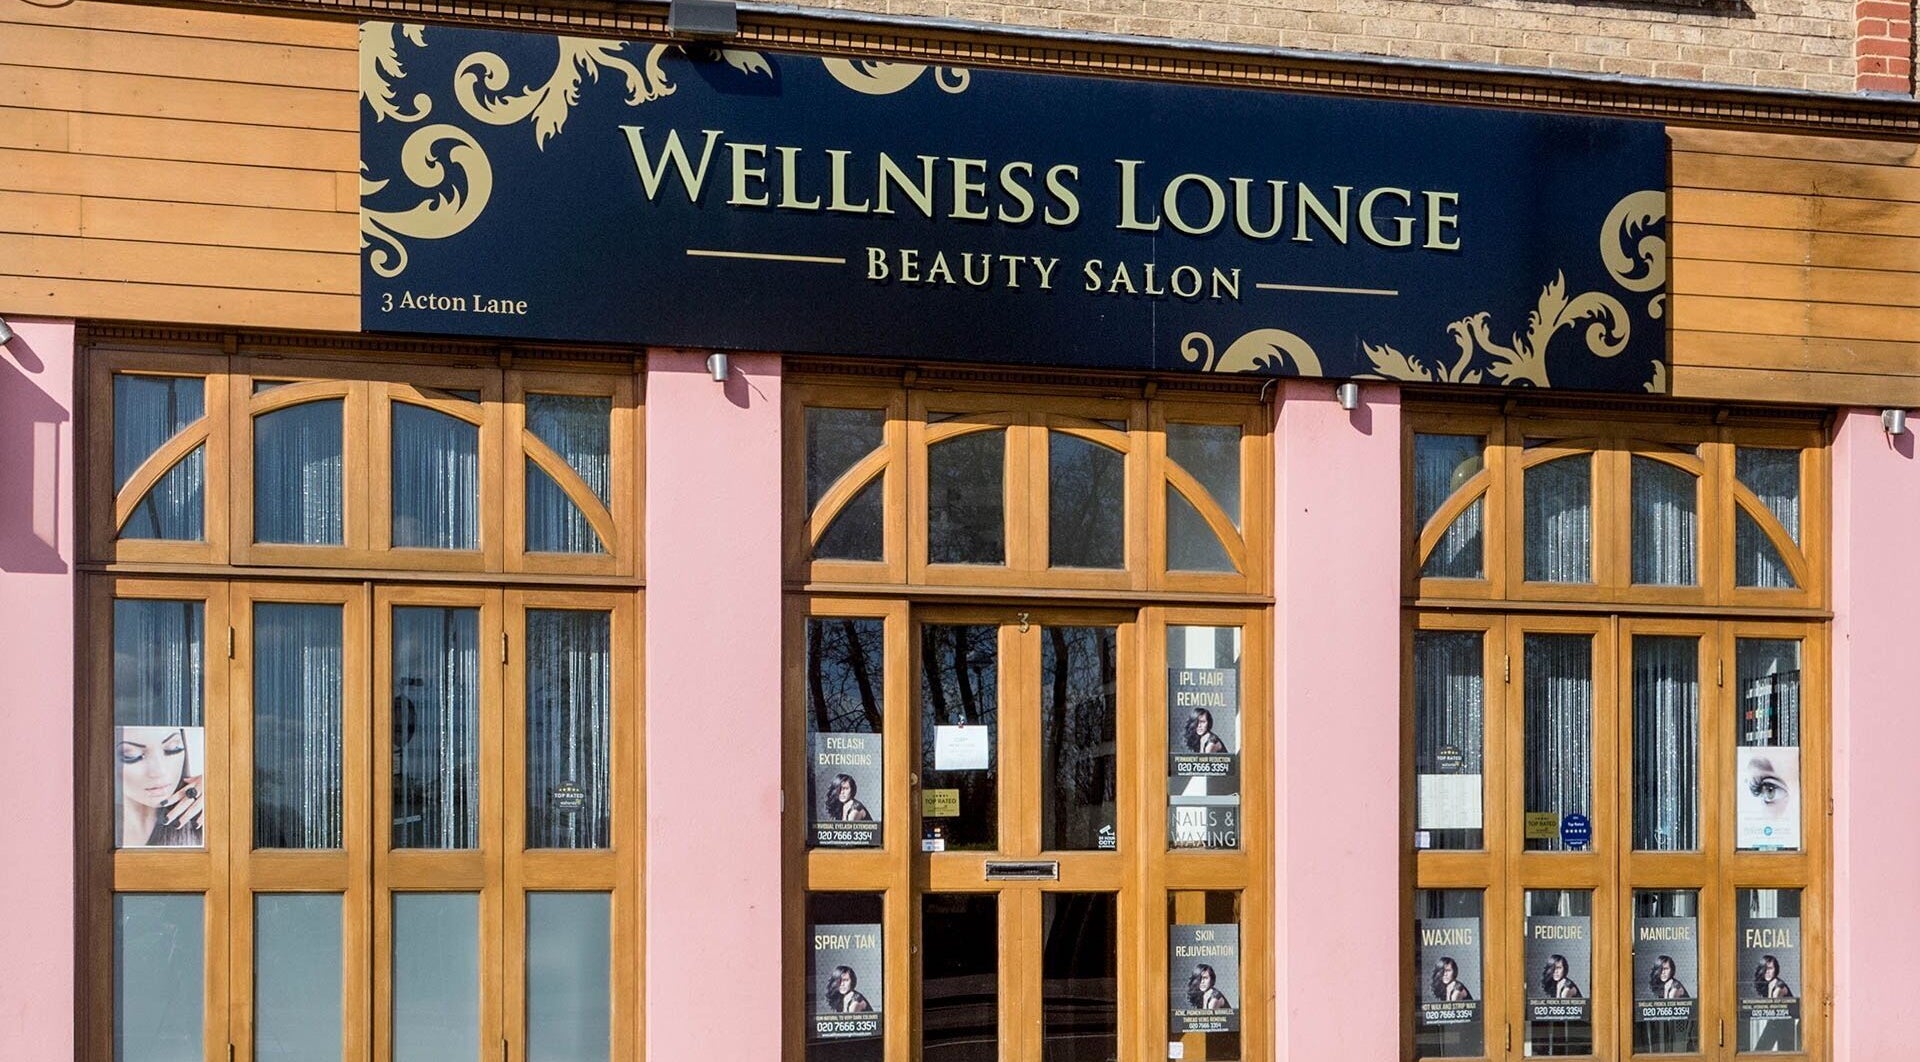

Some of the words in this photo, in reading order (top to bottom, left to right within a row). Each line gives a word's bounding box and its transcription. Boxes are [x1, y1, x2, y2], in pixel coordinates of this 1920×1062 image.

[618, 125, 1081, 226] WELLNESS
[1115, 159, 1461, 252] LOUNGE
[867, 247, 1060, 289] BEAUTY
[1084, 259, 1242, 300] SALON
[381, 292, 393, 312] 3
[399, 290, 466, 313] Acton
[472, 294, 527, 315] Lane
[1018, 612, 1029, 633] 3
[1180, 671, 1196, 686] IPL
[1199, 671, 1224, 686] HAIR
[1177, 692, 1227, 707] REMOVAL
[827, 738, 864, 749] EYELASH
[819, 753, 872, 766] EXTENSIONS
[1178, 763, 1192, 772] 020
[1193, 763, 1210, 772] 7666
[1211, 763, 1229, 772] 3354
[1172, 811, 1218, 827] NAILS
[1224, 811, 1234, 827] &
[818, 831, 832, 840] 020
[833, 831, 852, 840] 7666
[853, 831, 872, 840] 3354
[1171, 831, 1236, 847] WAXING
[1195, 930, 1214, 941] SKIN
[1422, 928, 1472, 946] WAXING
[1535, 926, 1582, 939] PEDICURE
[1640, 927, 1690, 941] MANICURE
[1746, 929, 1793, 948] FACIAL
[815, 935, 851, 950] SPRAY
[854, 934, 875, 949] TAN
[1176, 946, 1234, 957] REJUVENATION
[1426, 1011, 1439, 1019] 020
[1440, 1010, 1455, 1019] 7666
[1456, 1010, 1473, 1018] 3354
[1535, 1007, 1548, 1015] 020
[1549, 1007, 1565, 1015] 7666
[1566, 1007, 1583, 1015] 3354
[1643, 1008, 1656, 1016] 020
[1657, 1008, 1673, 1016] 7666
[1674, 1007, 1690, 1015] 3354
[817, 1022, 833, 1032] 020
[834, 1022, 855, 1031] 7666
[856, 1021, 877, 1031] 3354
